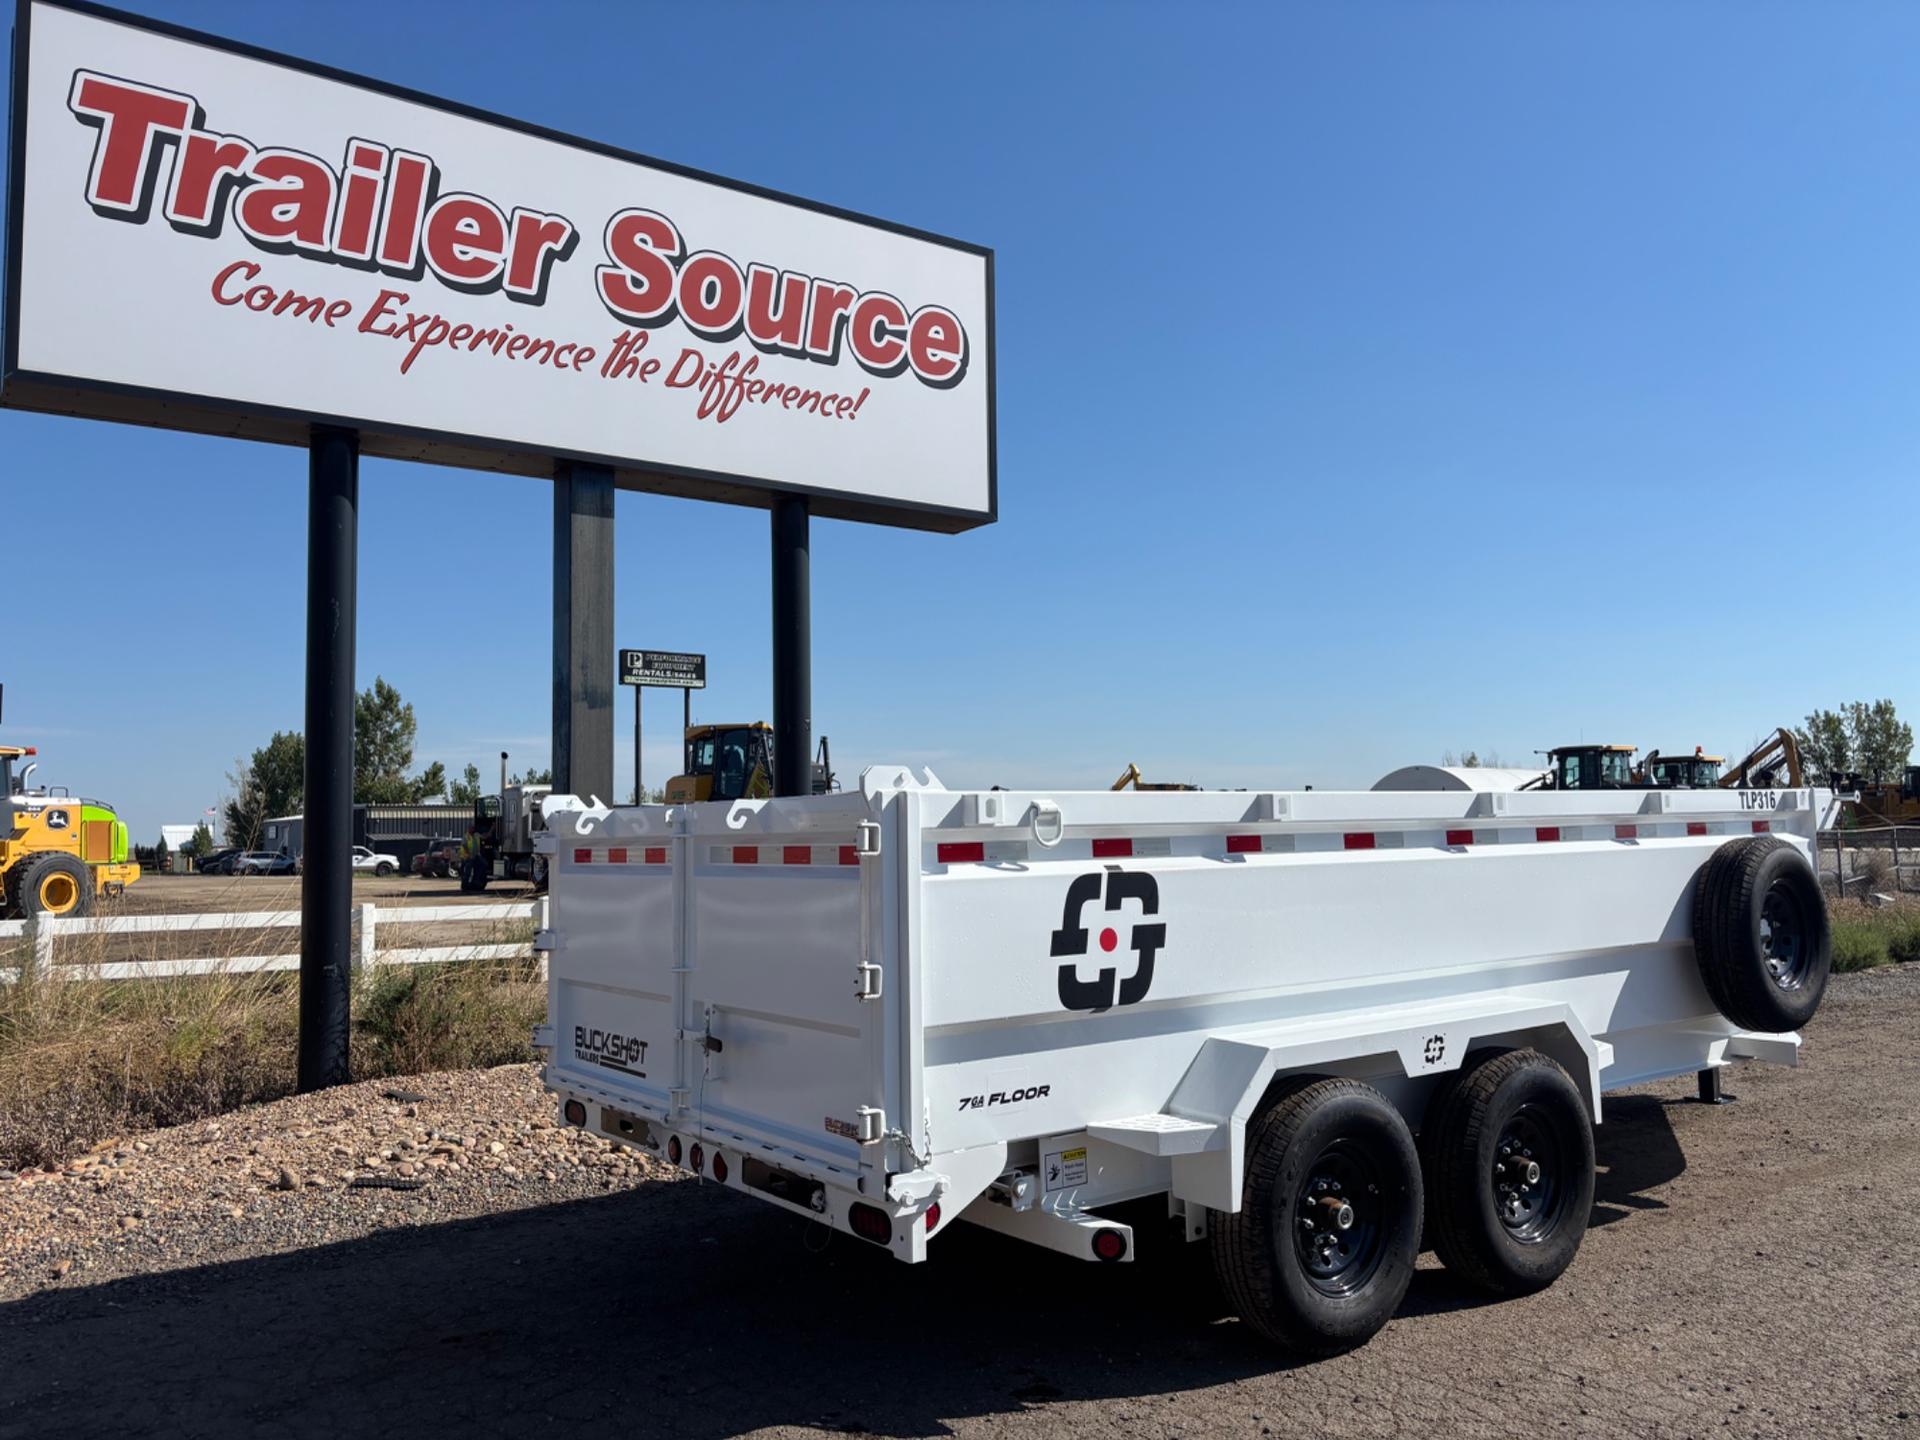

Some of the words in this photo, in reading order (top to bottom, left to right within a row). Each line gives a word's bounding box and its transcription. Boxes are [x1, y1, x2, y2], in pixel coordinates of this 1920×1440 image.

[68, 70, 579, 305] Trailer
[595, 207, 969, 389] Source
[211, 260, 351, 327] Come
[358, 289, 596, 374] Experience
[599, 330, 661, 383] the
[664, 349, 870, 423] Difference!
[1738, 790, 1776, 809] TLP316
[575, 1026, 648, 1065] BUCKSHOT
[575, 1049, 600, 1064] TRAILERS
[987, 1085, 1051, 1106] FLOOR
